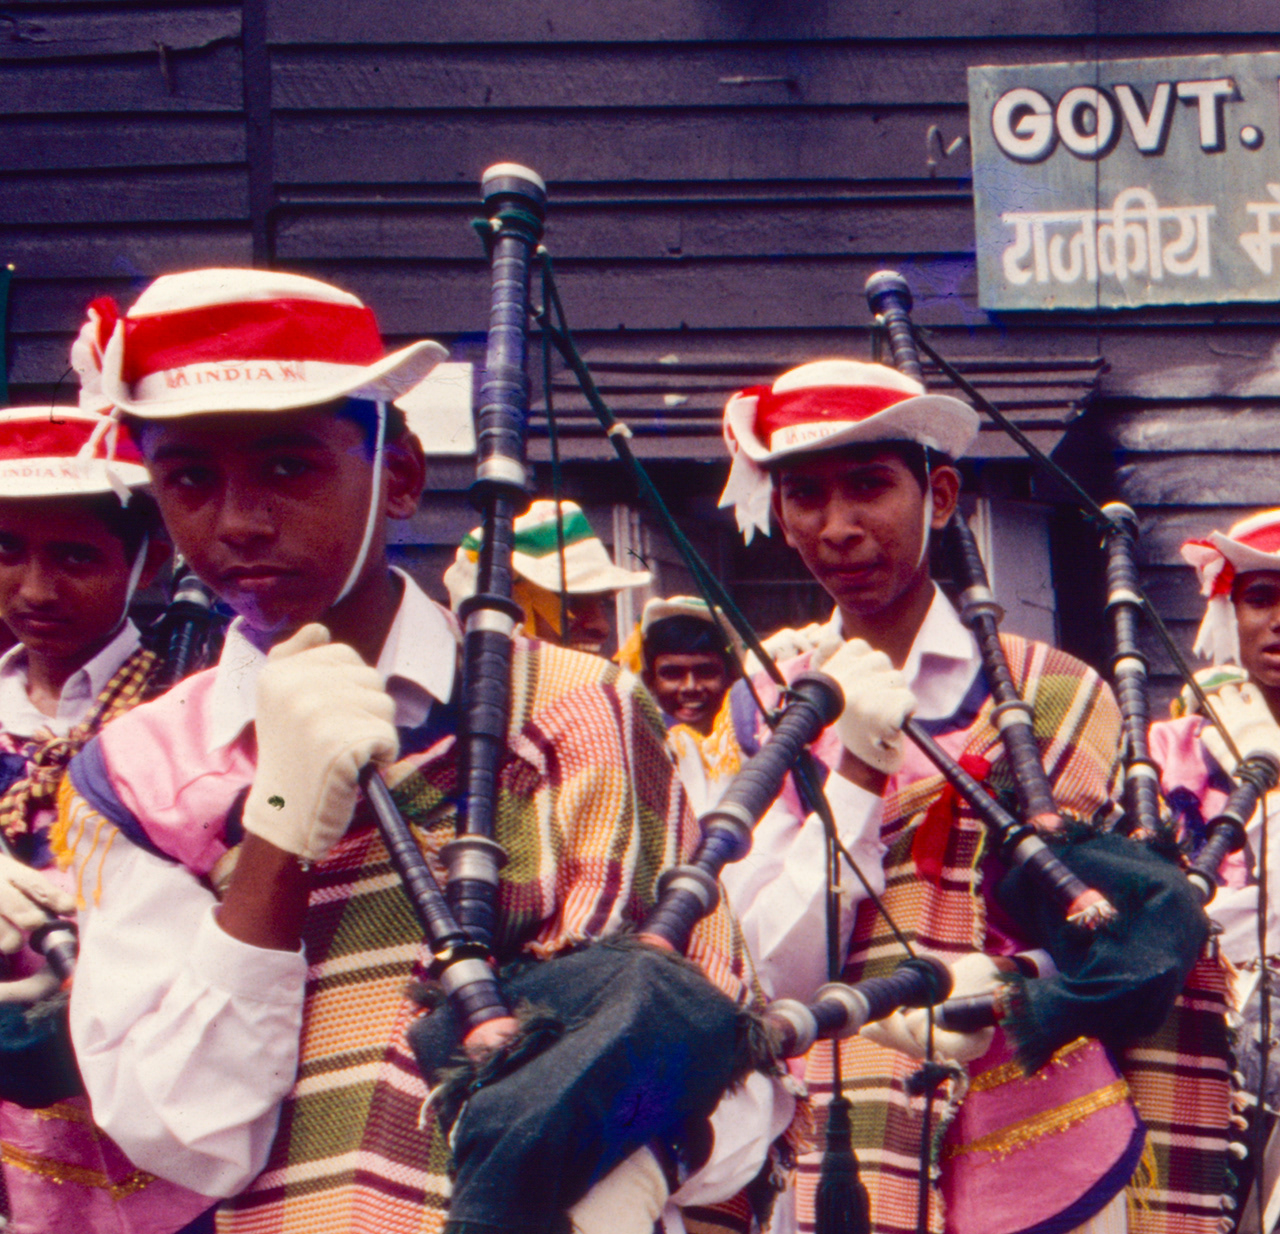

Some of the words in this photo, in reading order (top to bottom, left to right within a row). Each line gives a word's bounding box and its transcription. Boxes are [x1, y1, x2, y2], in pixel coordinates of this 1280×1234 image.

[991, 77, 1264, 163] GOVT.
[1001, 186, 1216, 286] राजकीय
[196, 367, 274, 385] INDIA
[2, 467, 56, 478] INDIA
